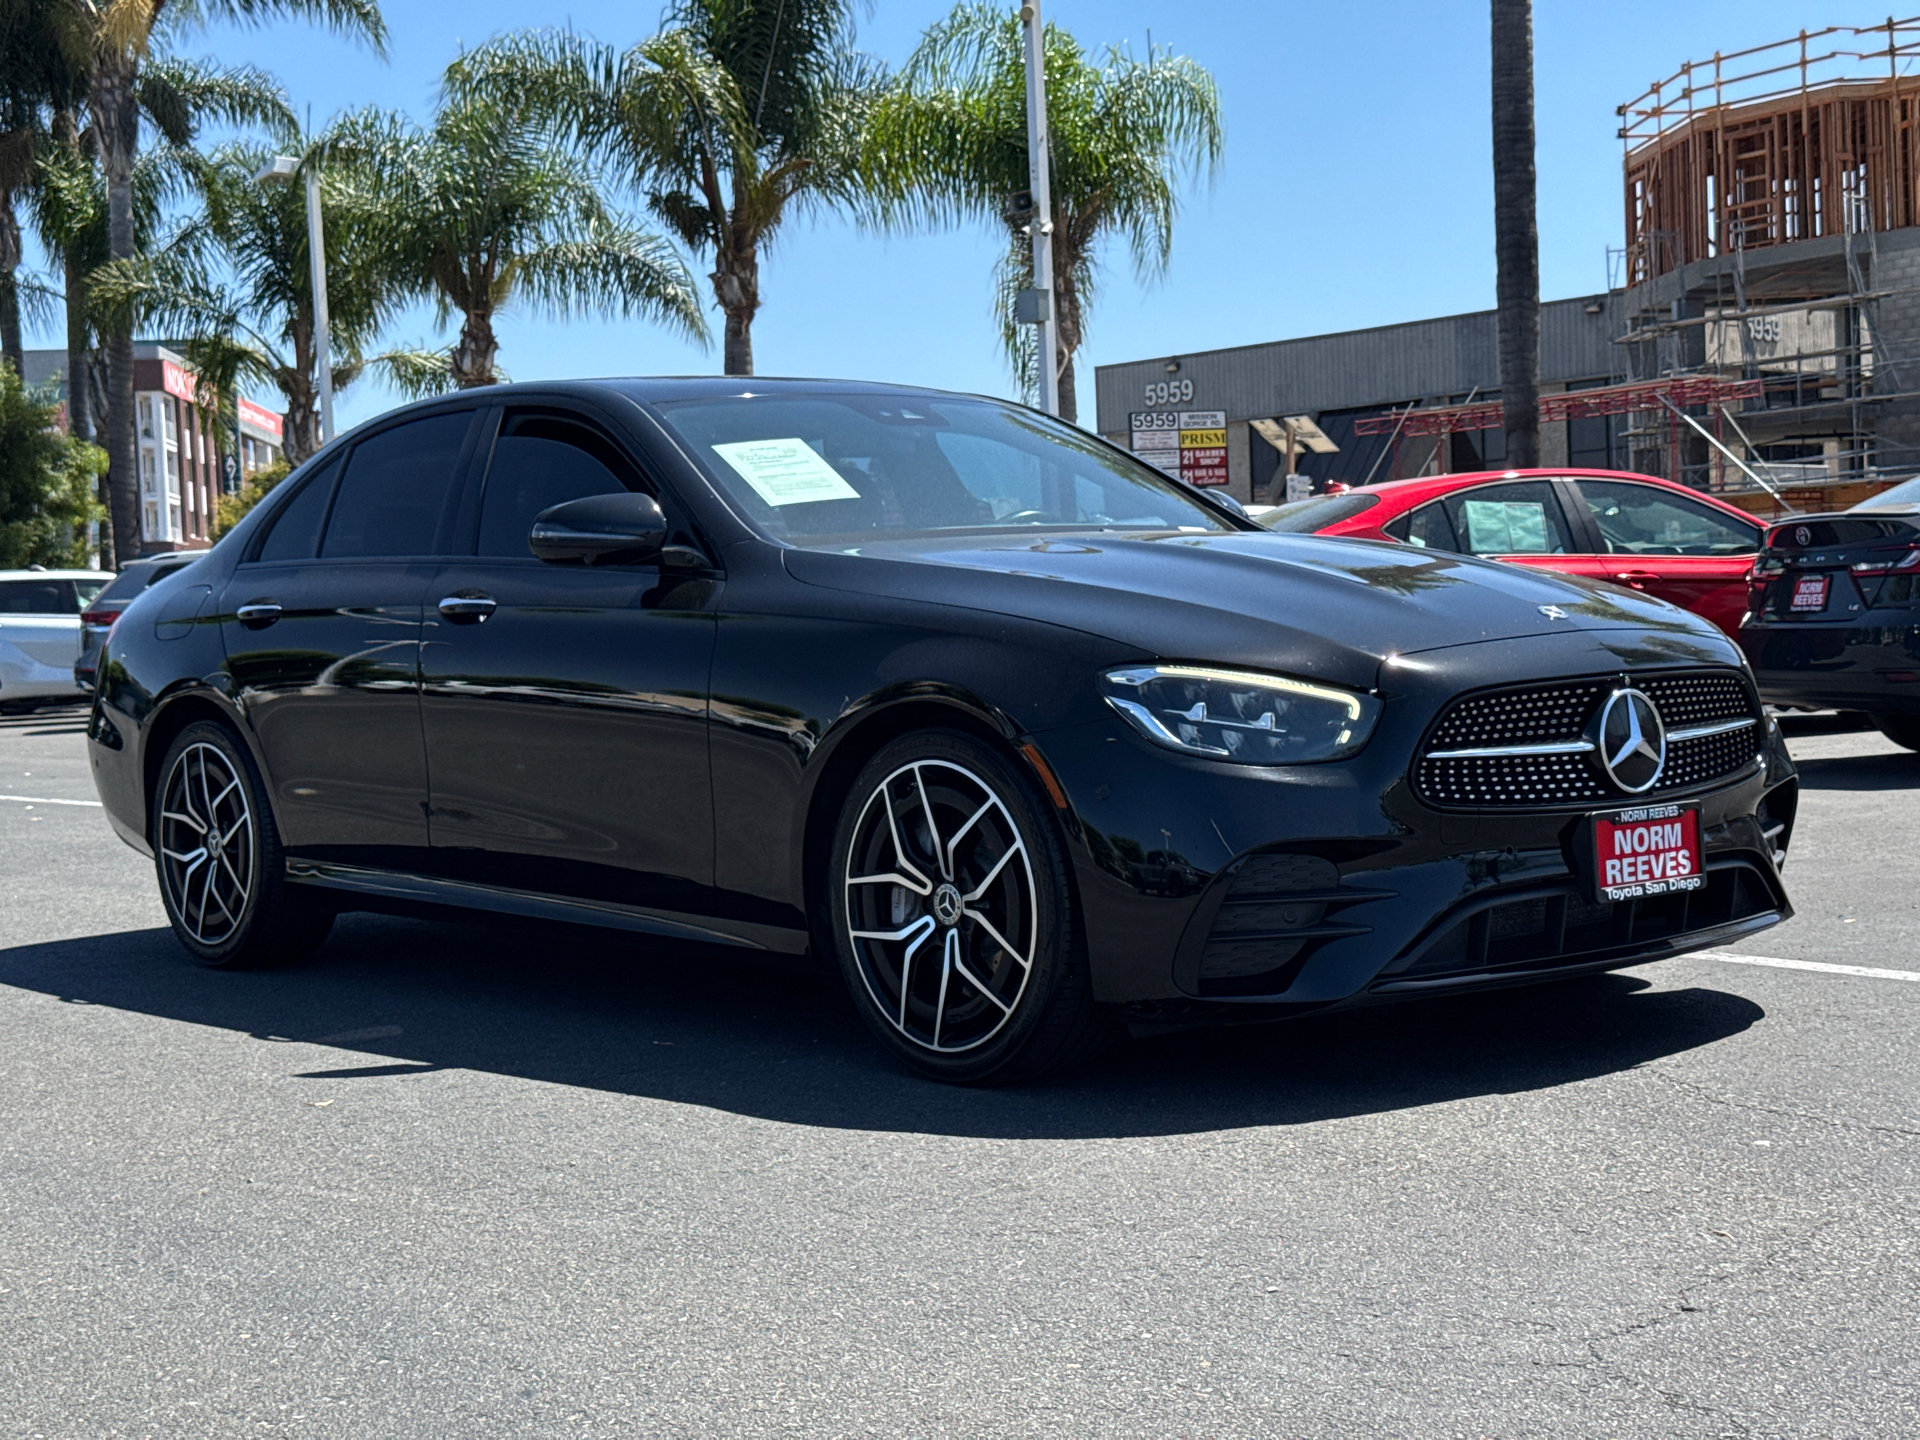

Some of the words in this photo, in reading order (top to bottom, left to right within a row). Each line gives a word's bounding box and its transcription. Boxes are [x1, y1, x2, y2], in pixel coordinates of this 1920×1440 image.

[1145, 380, 1193, 406] 5959
[1133, 413, 1176, 428] 5959
[1181, 433, 1225, 444] PRISM
[1182, 450, 1194, 465] 21
[1182, 469, 1194, 484] 21
[1620, 810, 1647, 822] NORM
[1649, 806, 1678, 819] REEVES
[1614, 823, 1682, 855] NORM
[1606, 849, 1691, 884] REEVES
[1607, 887, 1643, 900] Toyota
[1645, 882, 1667, 895] San
[1669, 878, 1700, 890] Diego
